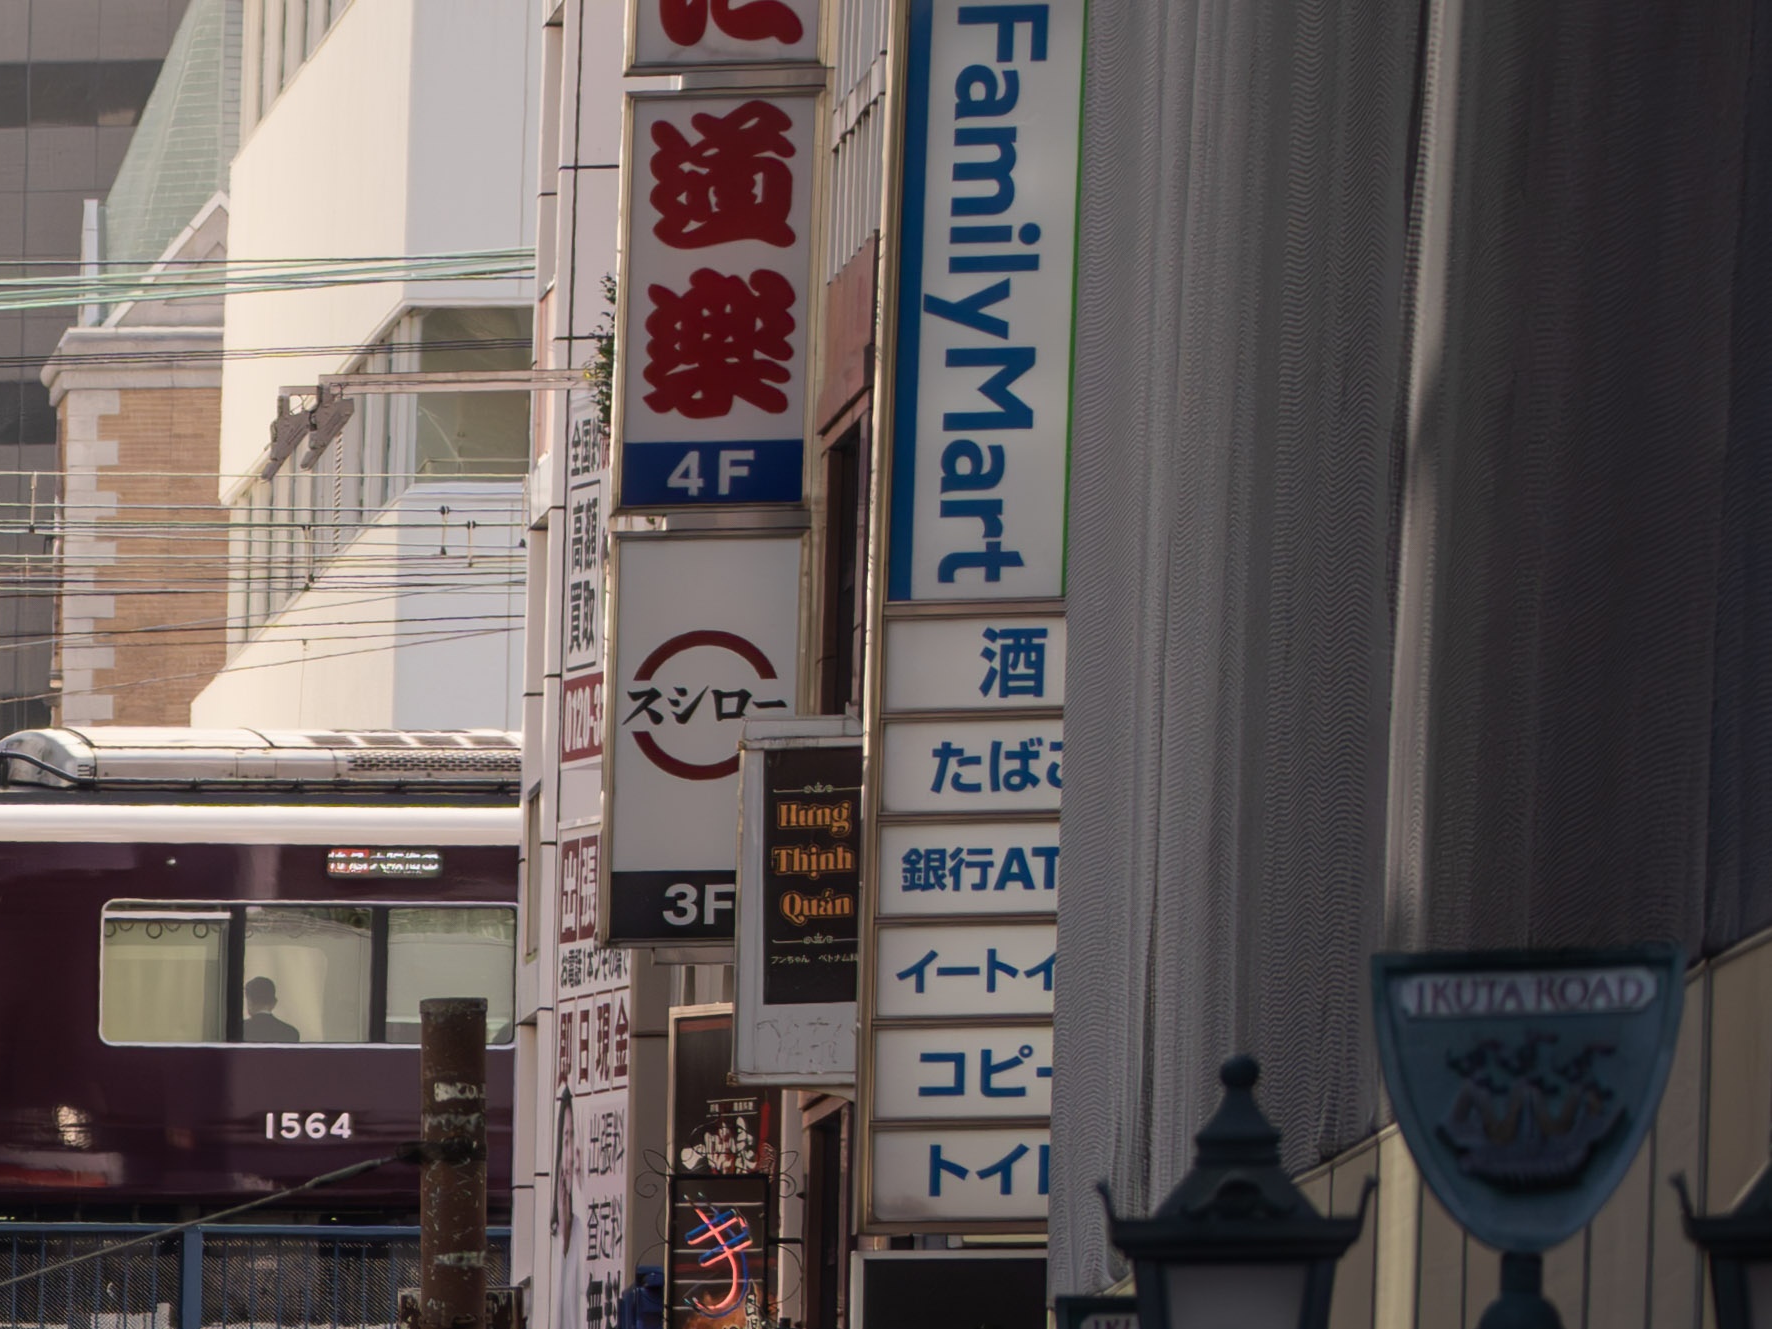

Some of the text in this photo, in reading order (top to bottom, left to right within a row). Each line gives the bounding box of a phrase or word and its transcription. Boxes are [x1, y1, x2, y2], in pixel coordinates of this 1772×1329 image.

[923, 3, 1049, 584] FamilyMart
[666, 449, 755, 497] 4F
[978, 627, 1048, 699] 酒
[621, 683, 787, 727] スシロー
[662, 882, 735, 927] 3F
[1415, 975, 1646, 1014] IKUTA ROAD
[264, 1112, 353, 1141] 1564
[929, 1142, 1049, 1198] トイ
